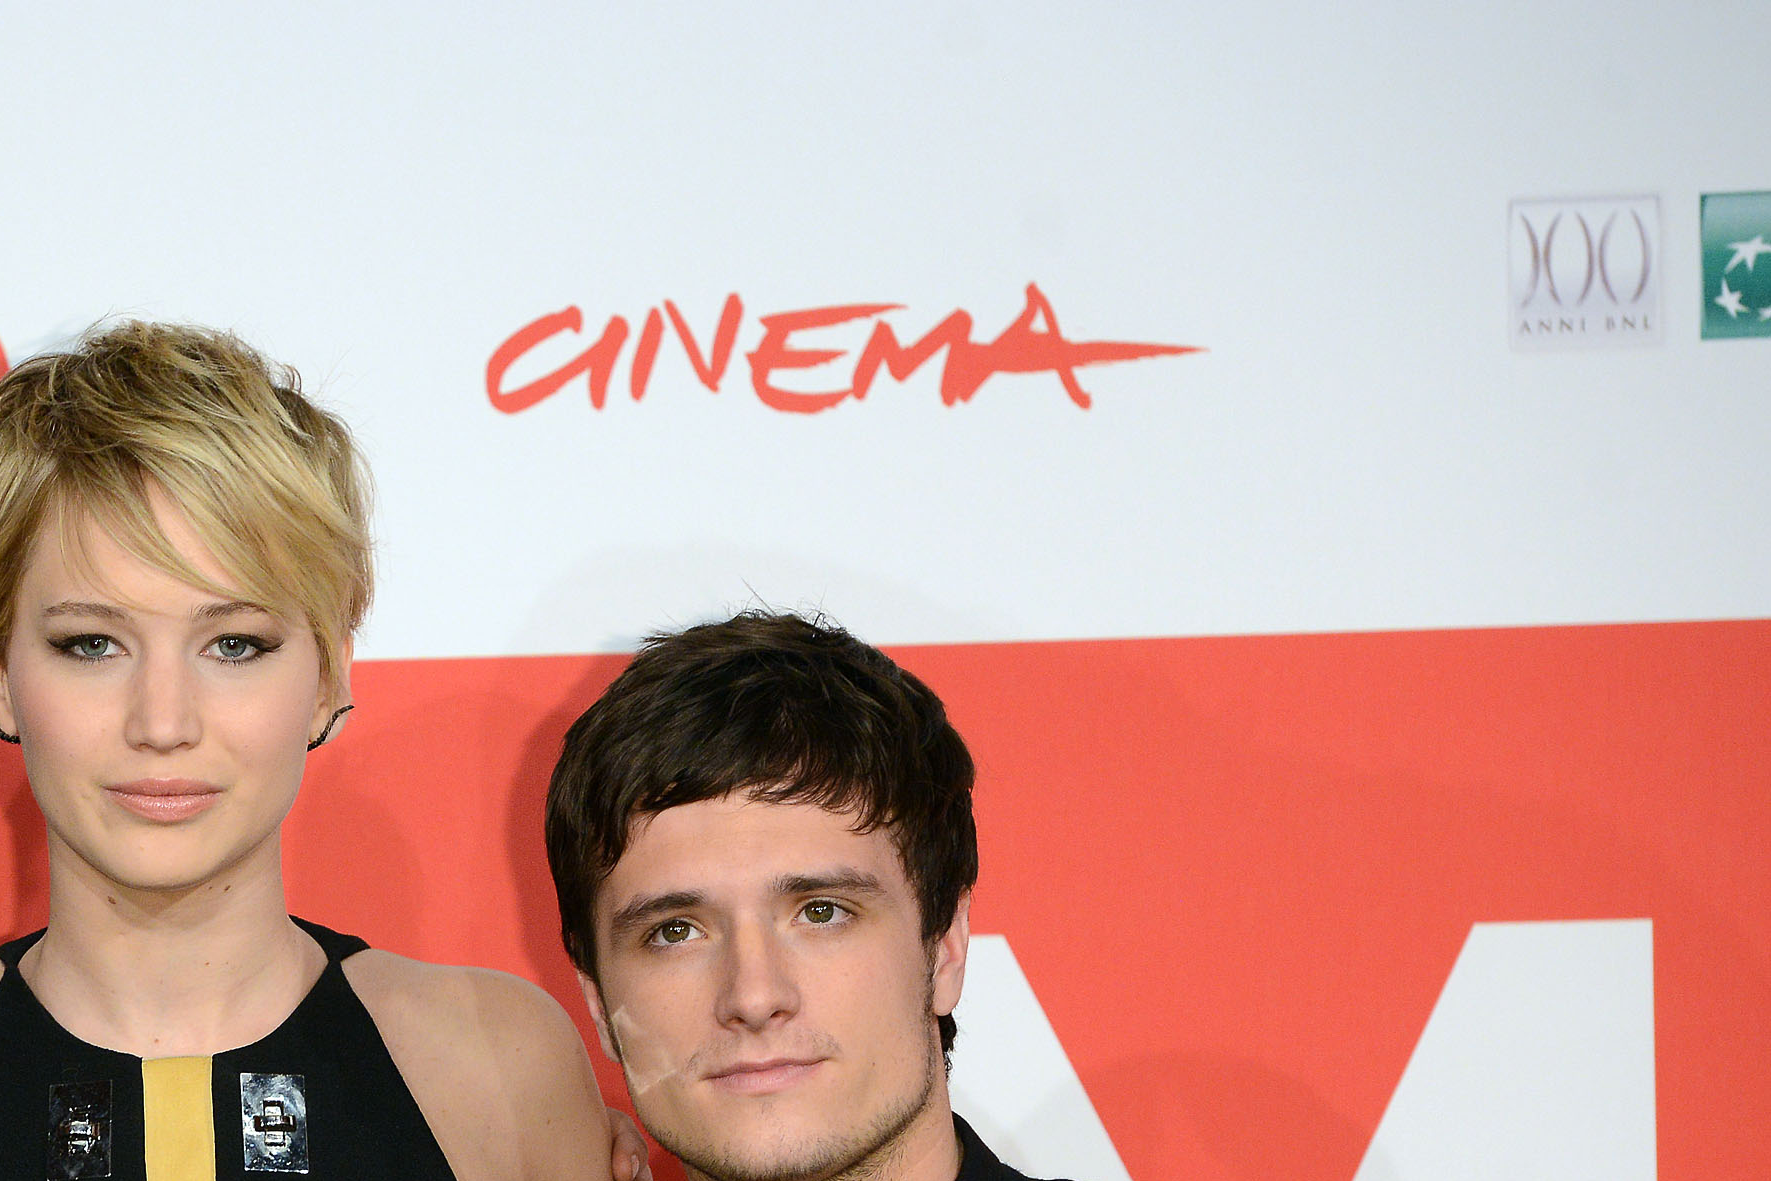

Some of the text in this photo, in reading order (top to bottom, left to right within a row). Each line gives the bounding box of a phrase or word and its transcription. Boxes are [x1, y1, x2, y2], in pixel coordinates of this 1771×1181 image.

[484, 281, 1210, 416] CINEMA
[1518, 314, 1653, 335] ANNI BNL
